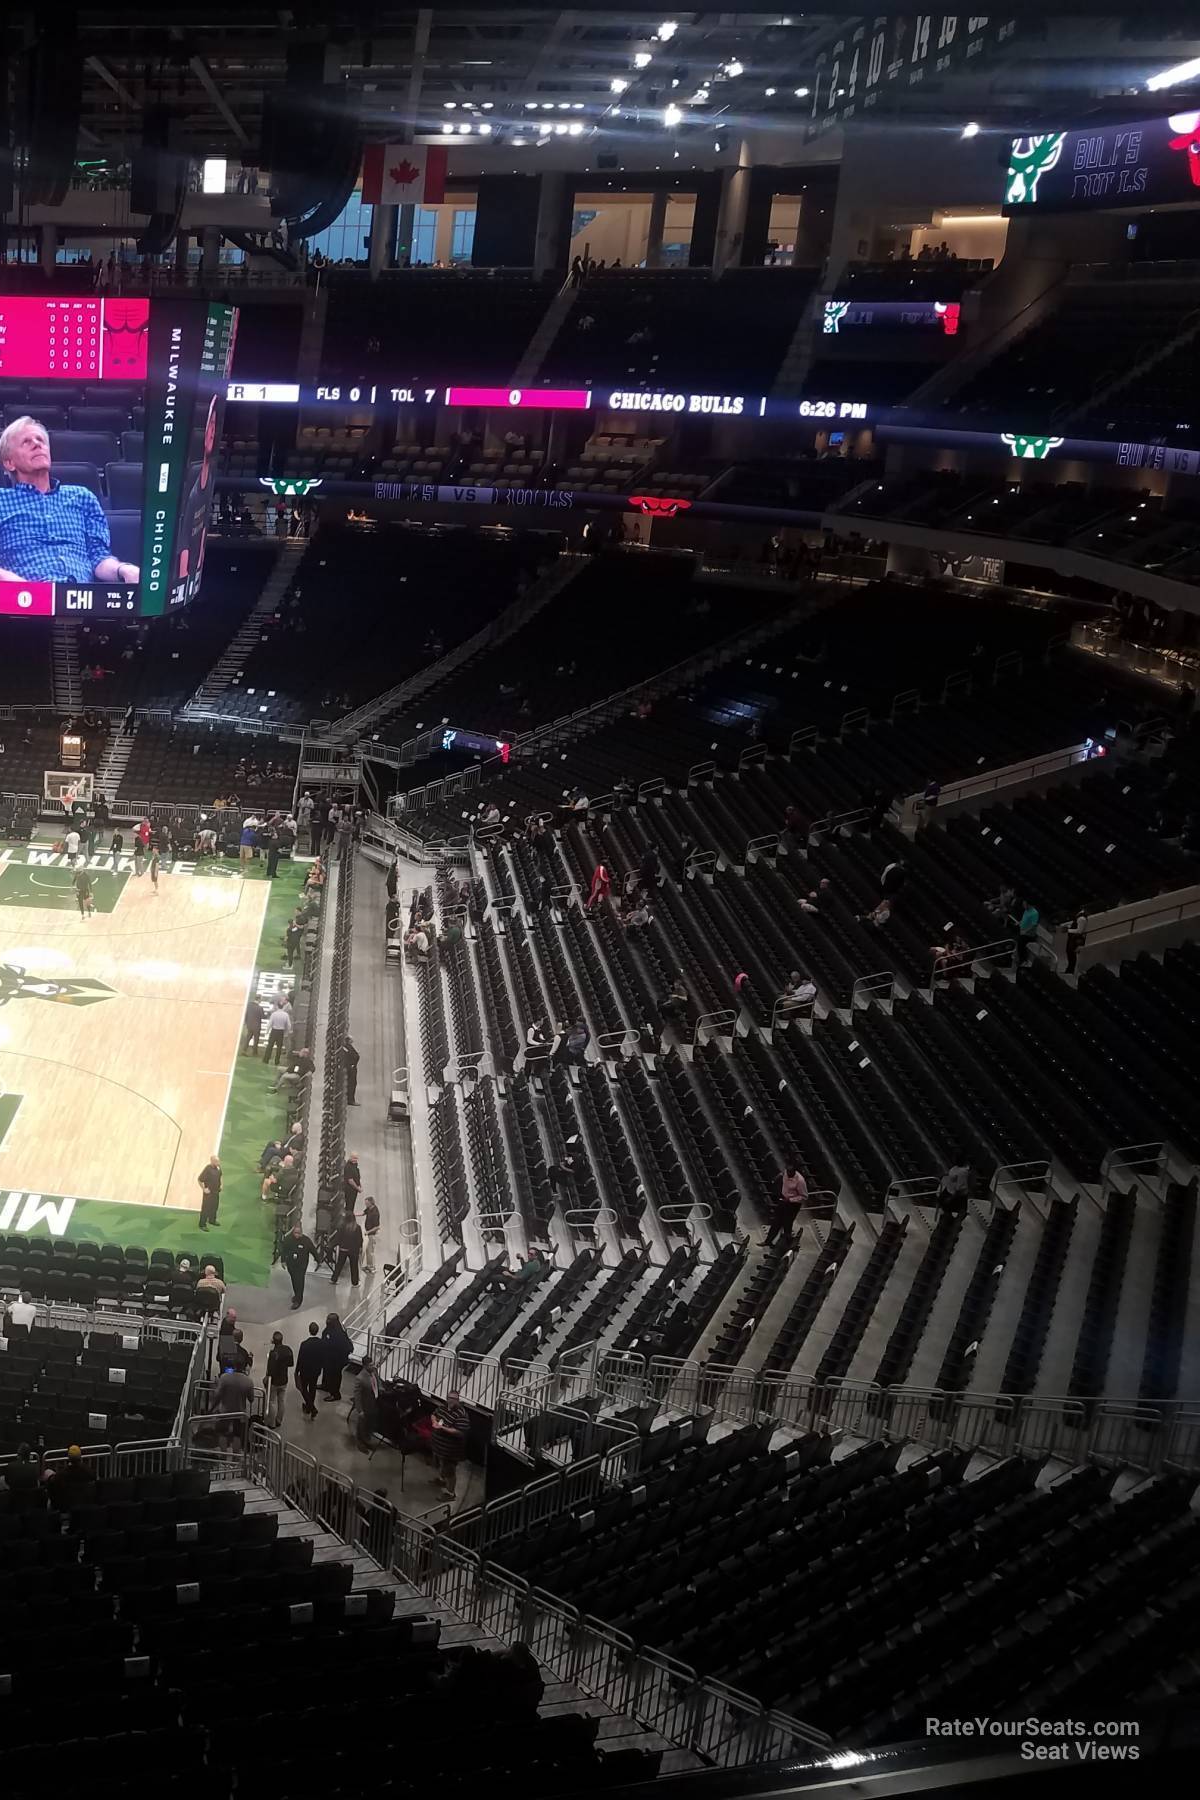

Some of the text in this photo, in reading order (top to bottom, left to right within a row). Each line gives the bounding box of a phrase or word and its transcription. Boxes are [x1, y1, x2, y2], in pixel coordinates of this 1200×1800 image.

[162, 328, 181, 444] MILWAUKEE
[260, 387, 266, 399] 1
[317, 388, 360, 401] FLS 0
[391, 389, 435, 402] TOL 7
[509, 389, 522, 405] 0
[609, 392, 744, 414] CHICAGO BULLS
[800, 400, 867, 418] 6:26 PM
[454, 489, 476, 501] VS
[150, 511, 165, 591] CHICAGO
[17, 591, 32, 607] 0
[66, 590, 93, 609] CHI
